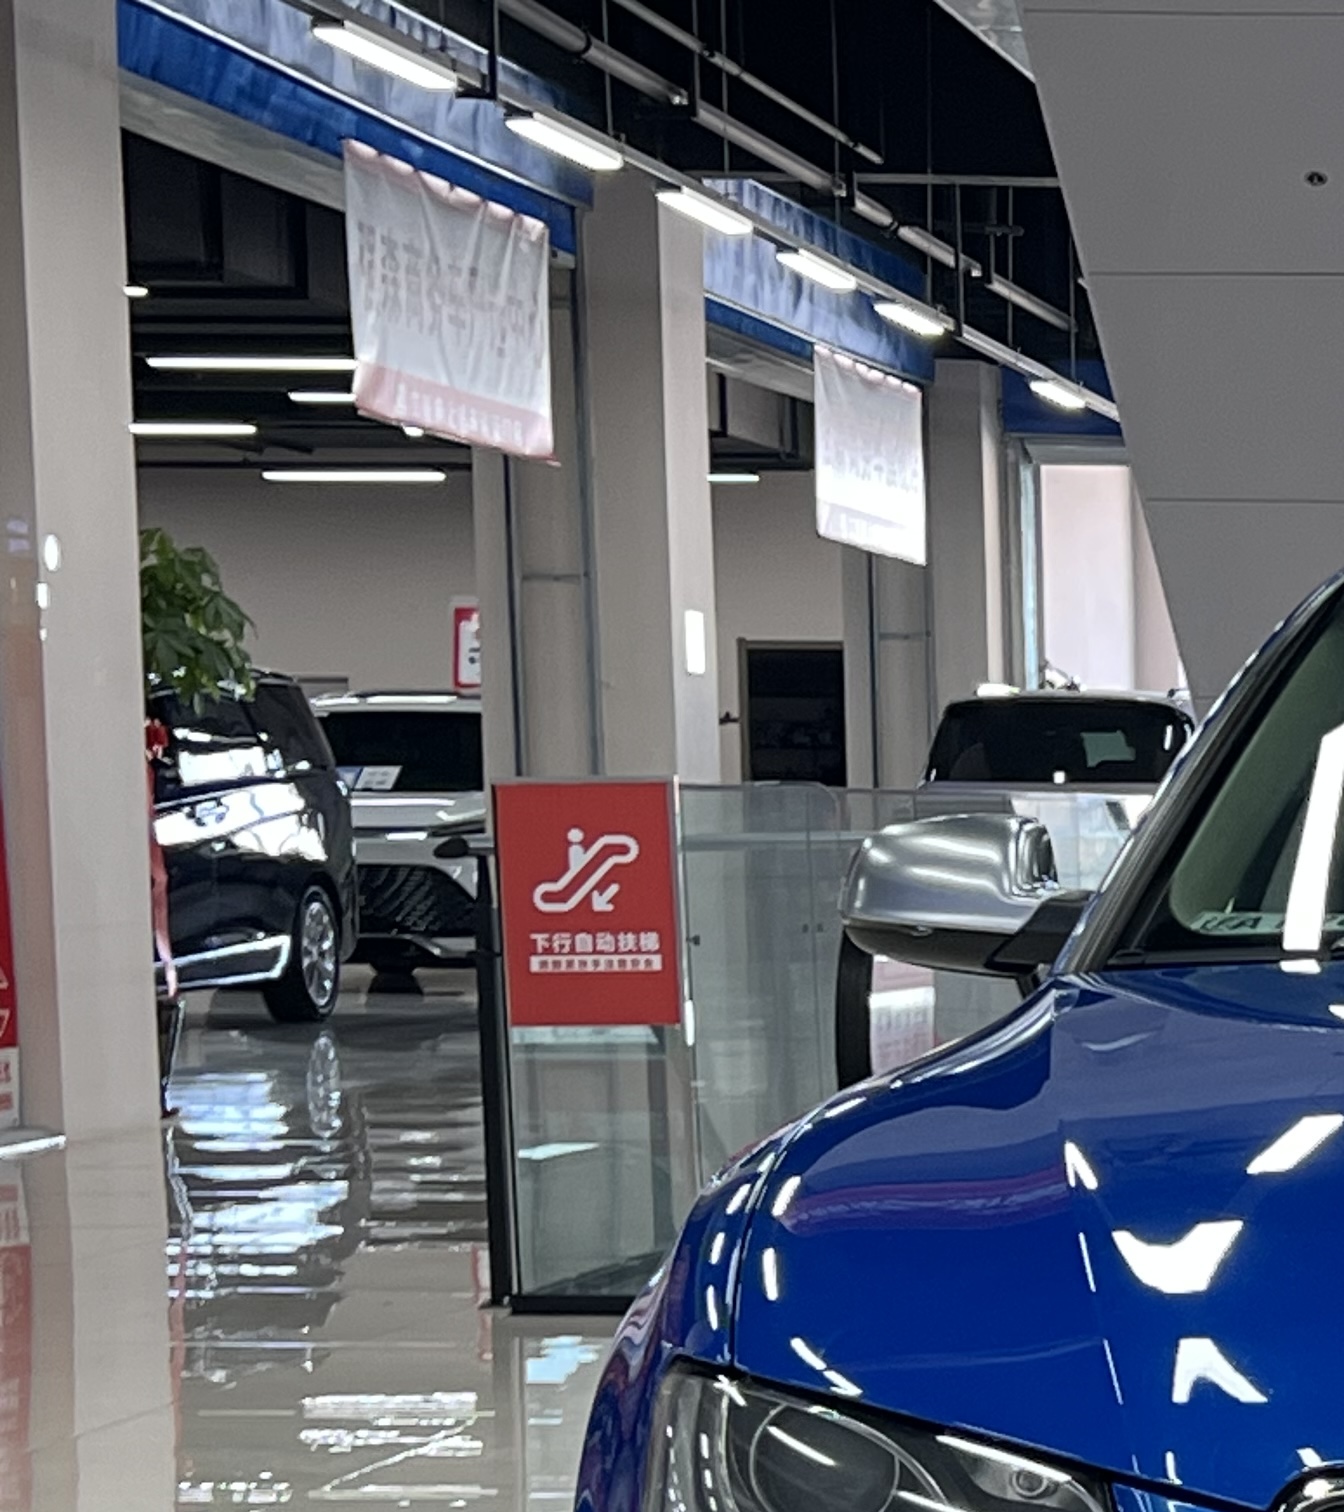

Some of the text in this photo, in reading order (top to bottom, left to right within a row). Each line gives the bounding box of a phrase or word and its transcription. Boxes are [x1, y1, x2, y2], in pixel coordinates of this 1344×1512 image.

[530, 931, 660, 953] 下行自动扶梯
